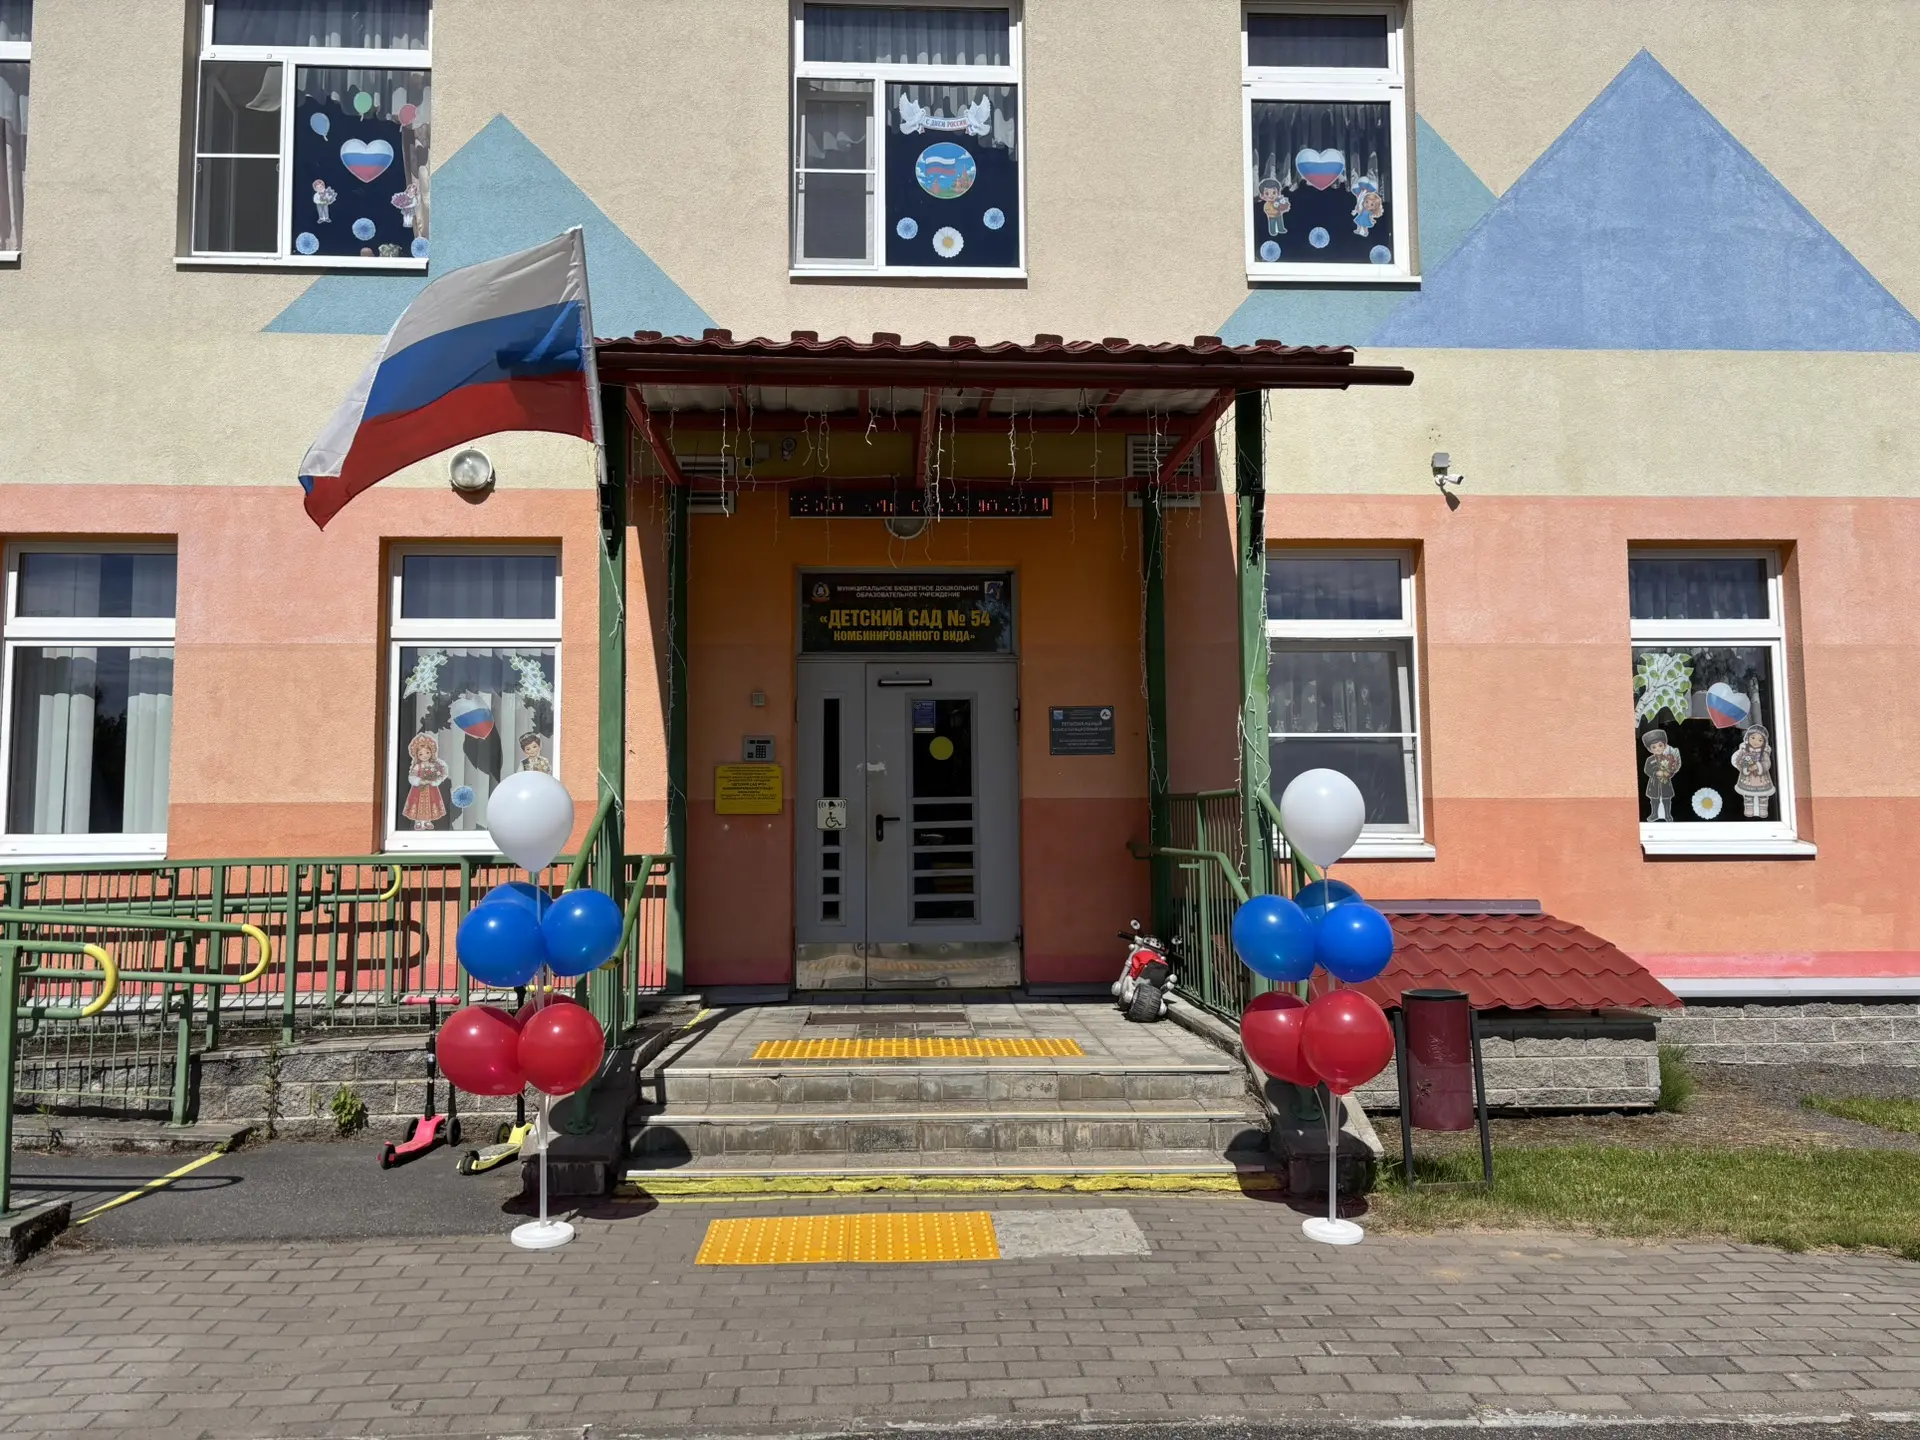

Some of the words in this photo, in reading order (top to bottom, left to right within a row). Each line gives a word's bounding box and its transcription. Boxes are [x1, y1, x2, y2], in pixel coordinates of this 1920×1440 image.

[819, 607, 903, 629] «ДЕТСКИЙ
[908, 609, 943, 629] САД
[947, 609, 966, 626] №
[970, 609, 991, 627] 54
[833, 630, 940, 641] КОМБИНИРОВАННОГО
[942, 630, 976, 643] ВИДА»
